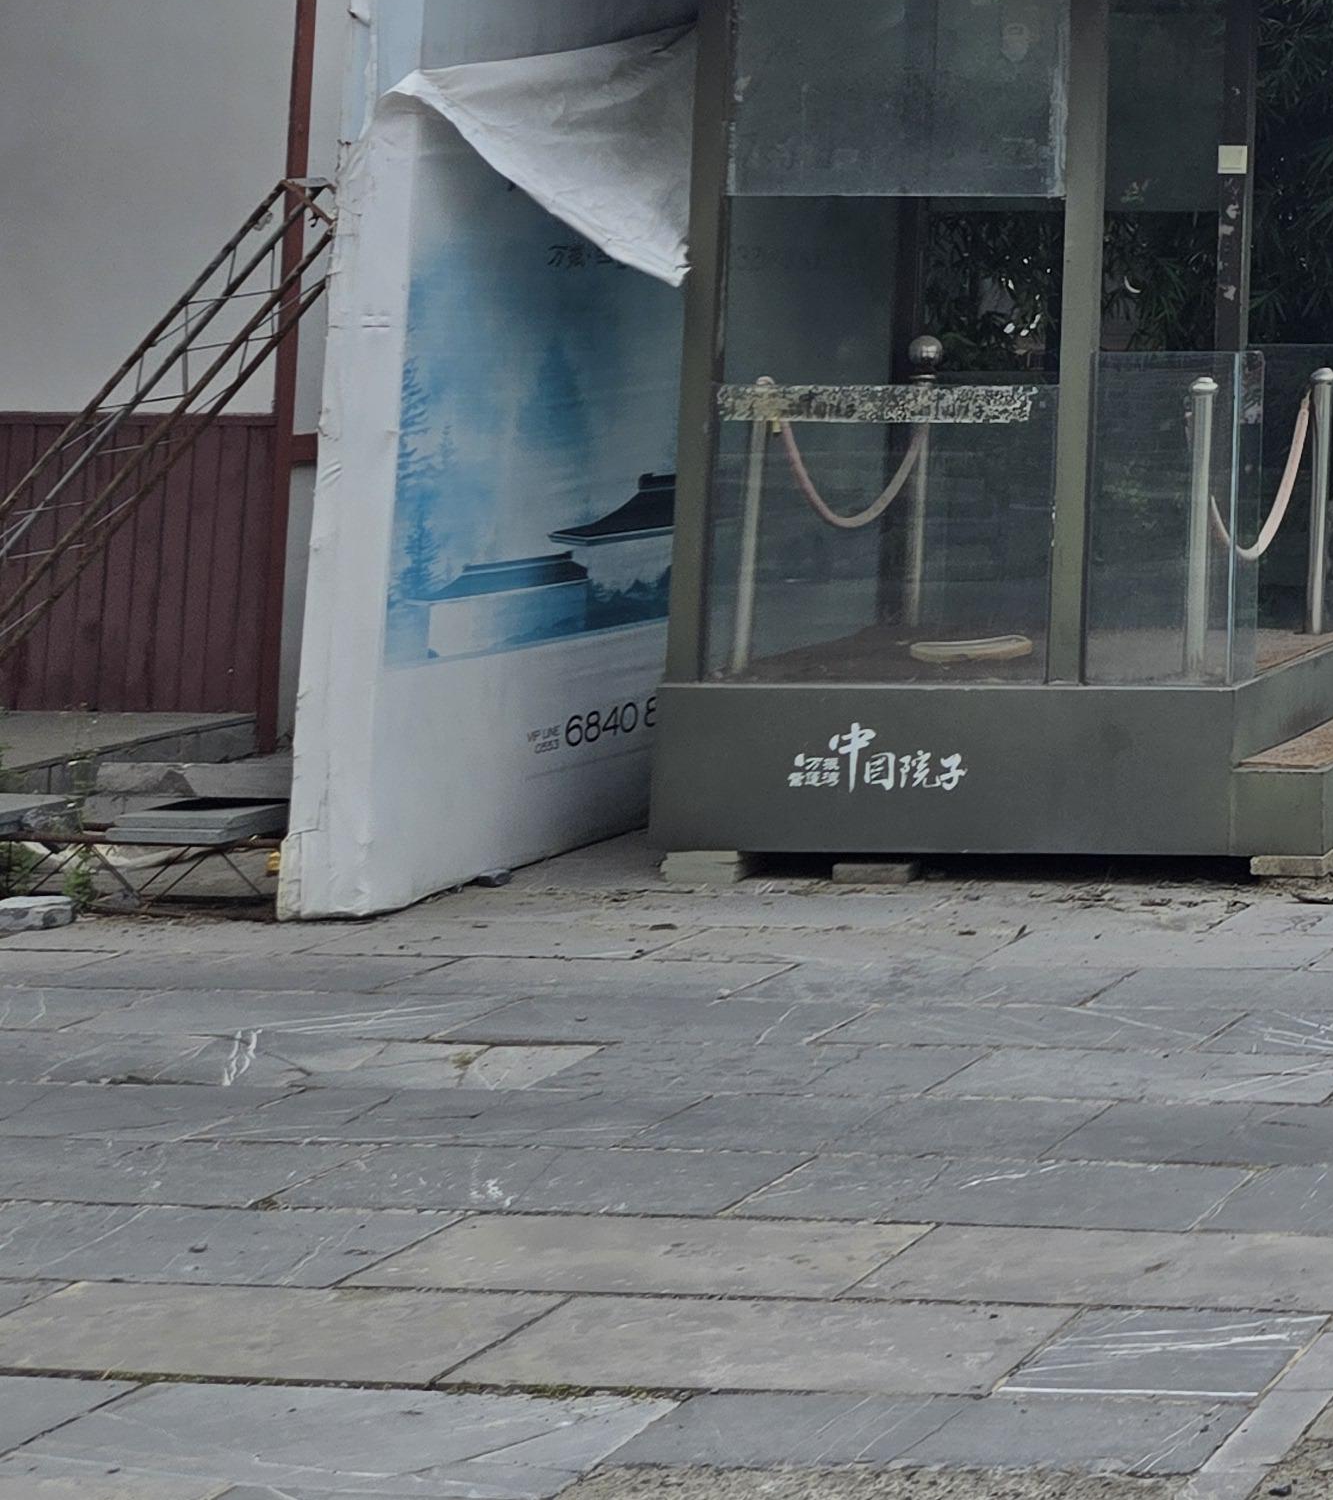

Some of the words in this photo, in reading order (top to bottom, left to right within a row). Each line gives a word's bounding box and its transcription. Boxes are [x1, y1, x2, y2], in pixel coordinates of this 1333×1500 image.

[565, 702, 639, 747] 6840
[828, 722, 969, 794] 中国院子
